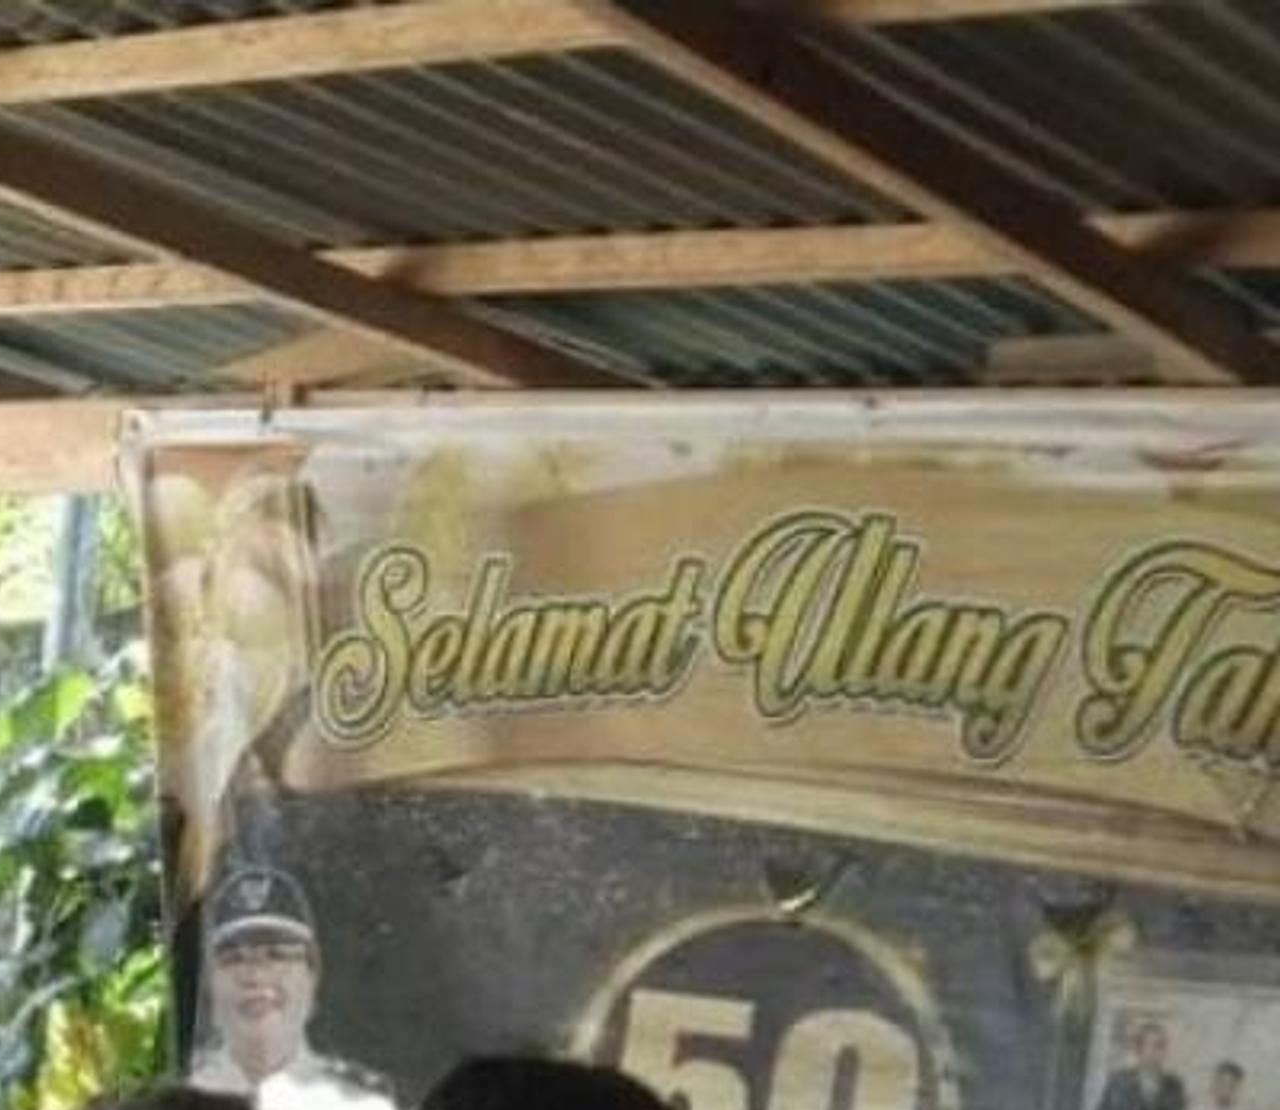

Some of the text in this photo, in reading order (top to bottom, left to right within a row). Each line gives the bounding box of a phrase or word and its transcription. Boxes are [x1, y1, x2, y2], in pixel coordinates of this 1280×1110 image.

[318, 510, 1280, 764] Selamat Ulang Ta
